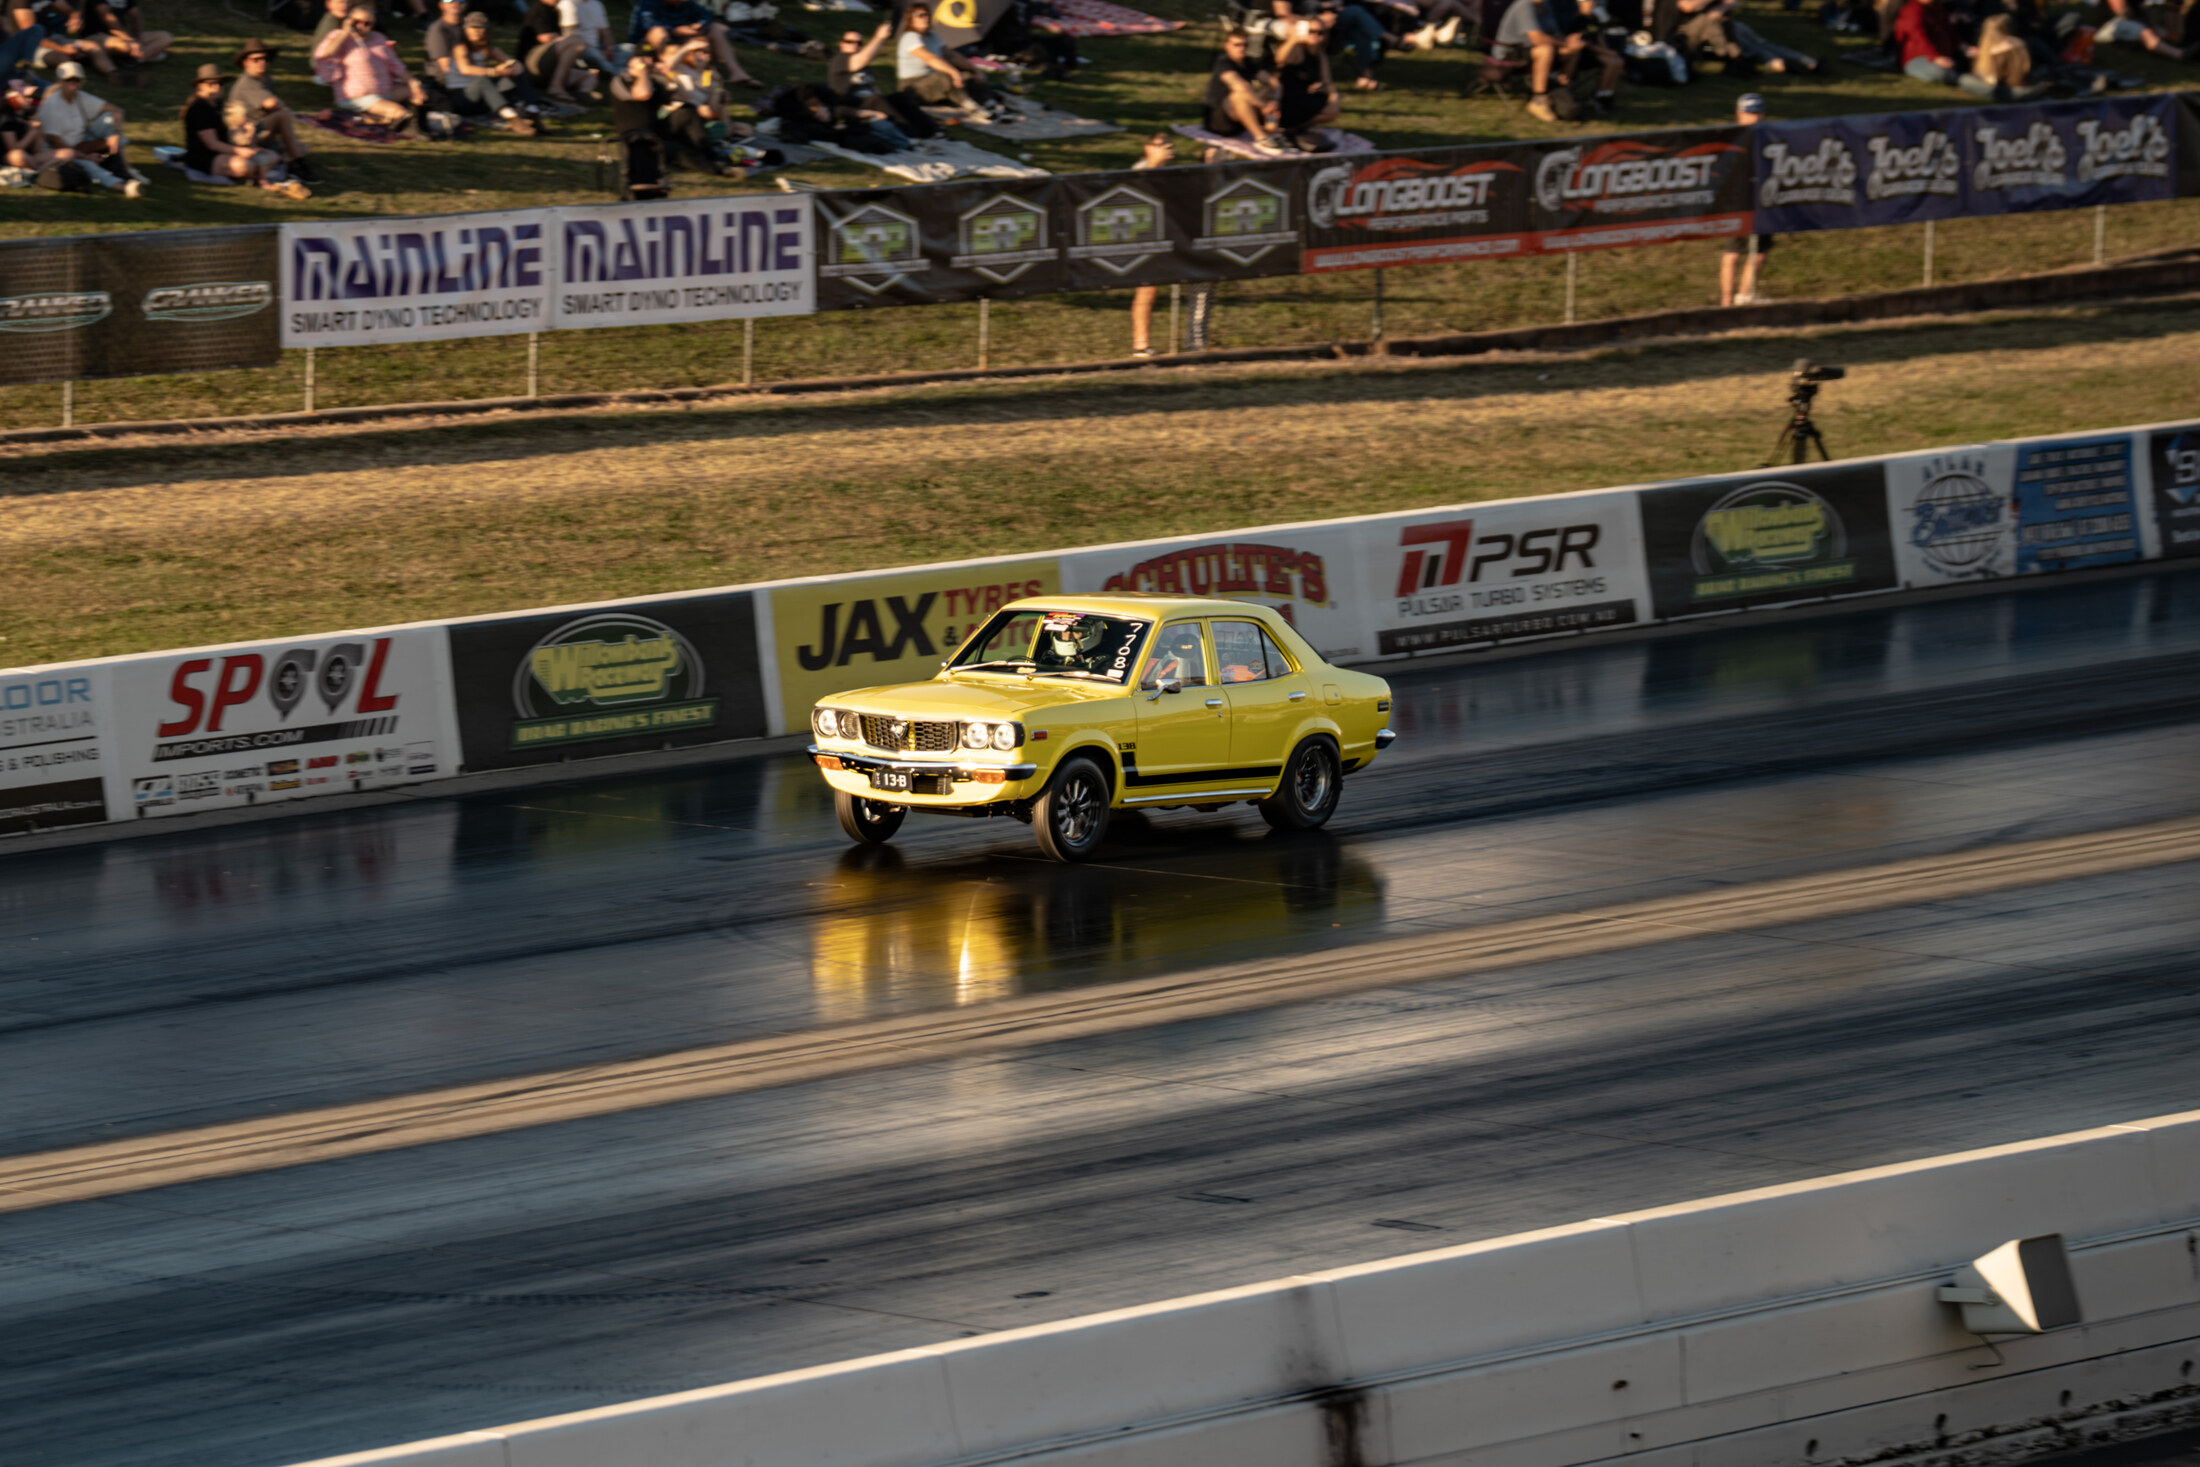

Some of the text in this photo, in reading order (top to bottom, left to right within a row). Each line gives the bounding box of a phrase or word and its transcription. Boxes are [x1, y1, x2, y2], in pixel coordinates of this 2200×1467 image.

[1866, 130, 1959, 201] Joel's
[1973, 122, 2066, 191] Joel's
[2076, 114, 2169, 183] Joel's
[1760, 138, 1857, 207] Joel's
[290, 297, 542, 334] SMART DYNO TECHNOLOGY
[562, 281, 803, 314] SMART DYNO TECHNOLOGY
[1469, 523, 1600, 582] PSR
[943, 580, 1044, 617] TYRES
[1397, 577, 1608, 618] PULSAR TURBO SYSTEMS
[796, 591, 940, 672] JAX
[943, 625, 960, 647] &
[1113, 622, 1144, 669] 7708
[0, 678, 92, 711] OOR
[157, 637, 400, 738] SPOOL
[652, 705, 714, 725] FINEST
[23, 748, 99, 768] POLISHING
[154, 730, 304, 761] IMPORTS.COM
